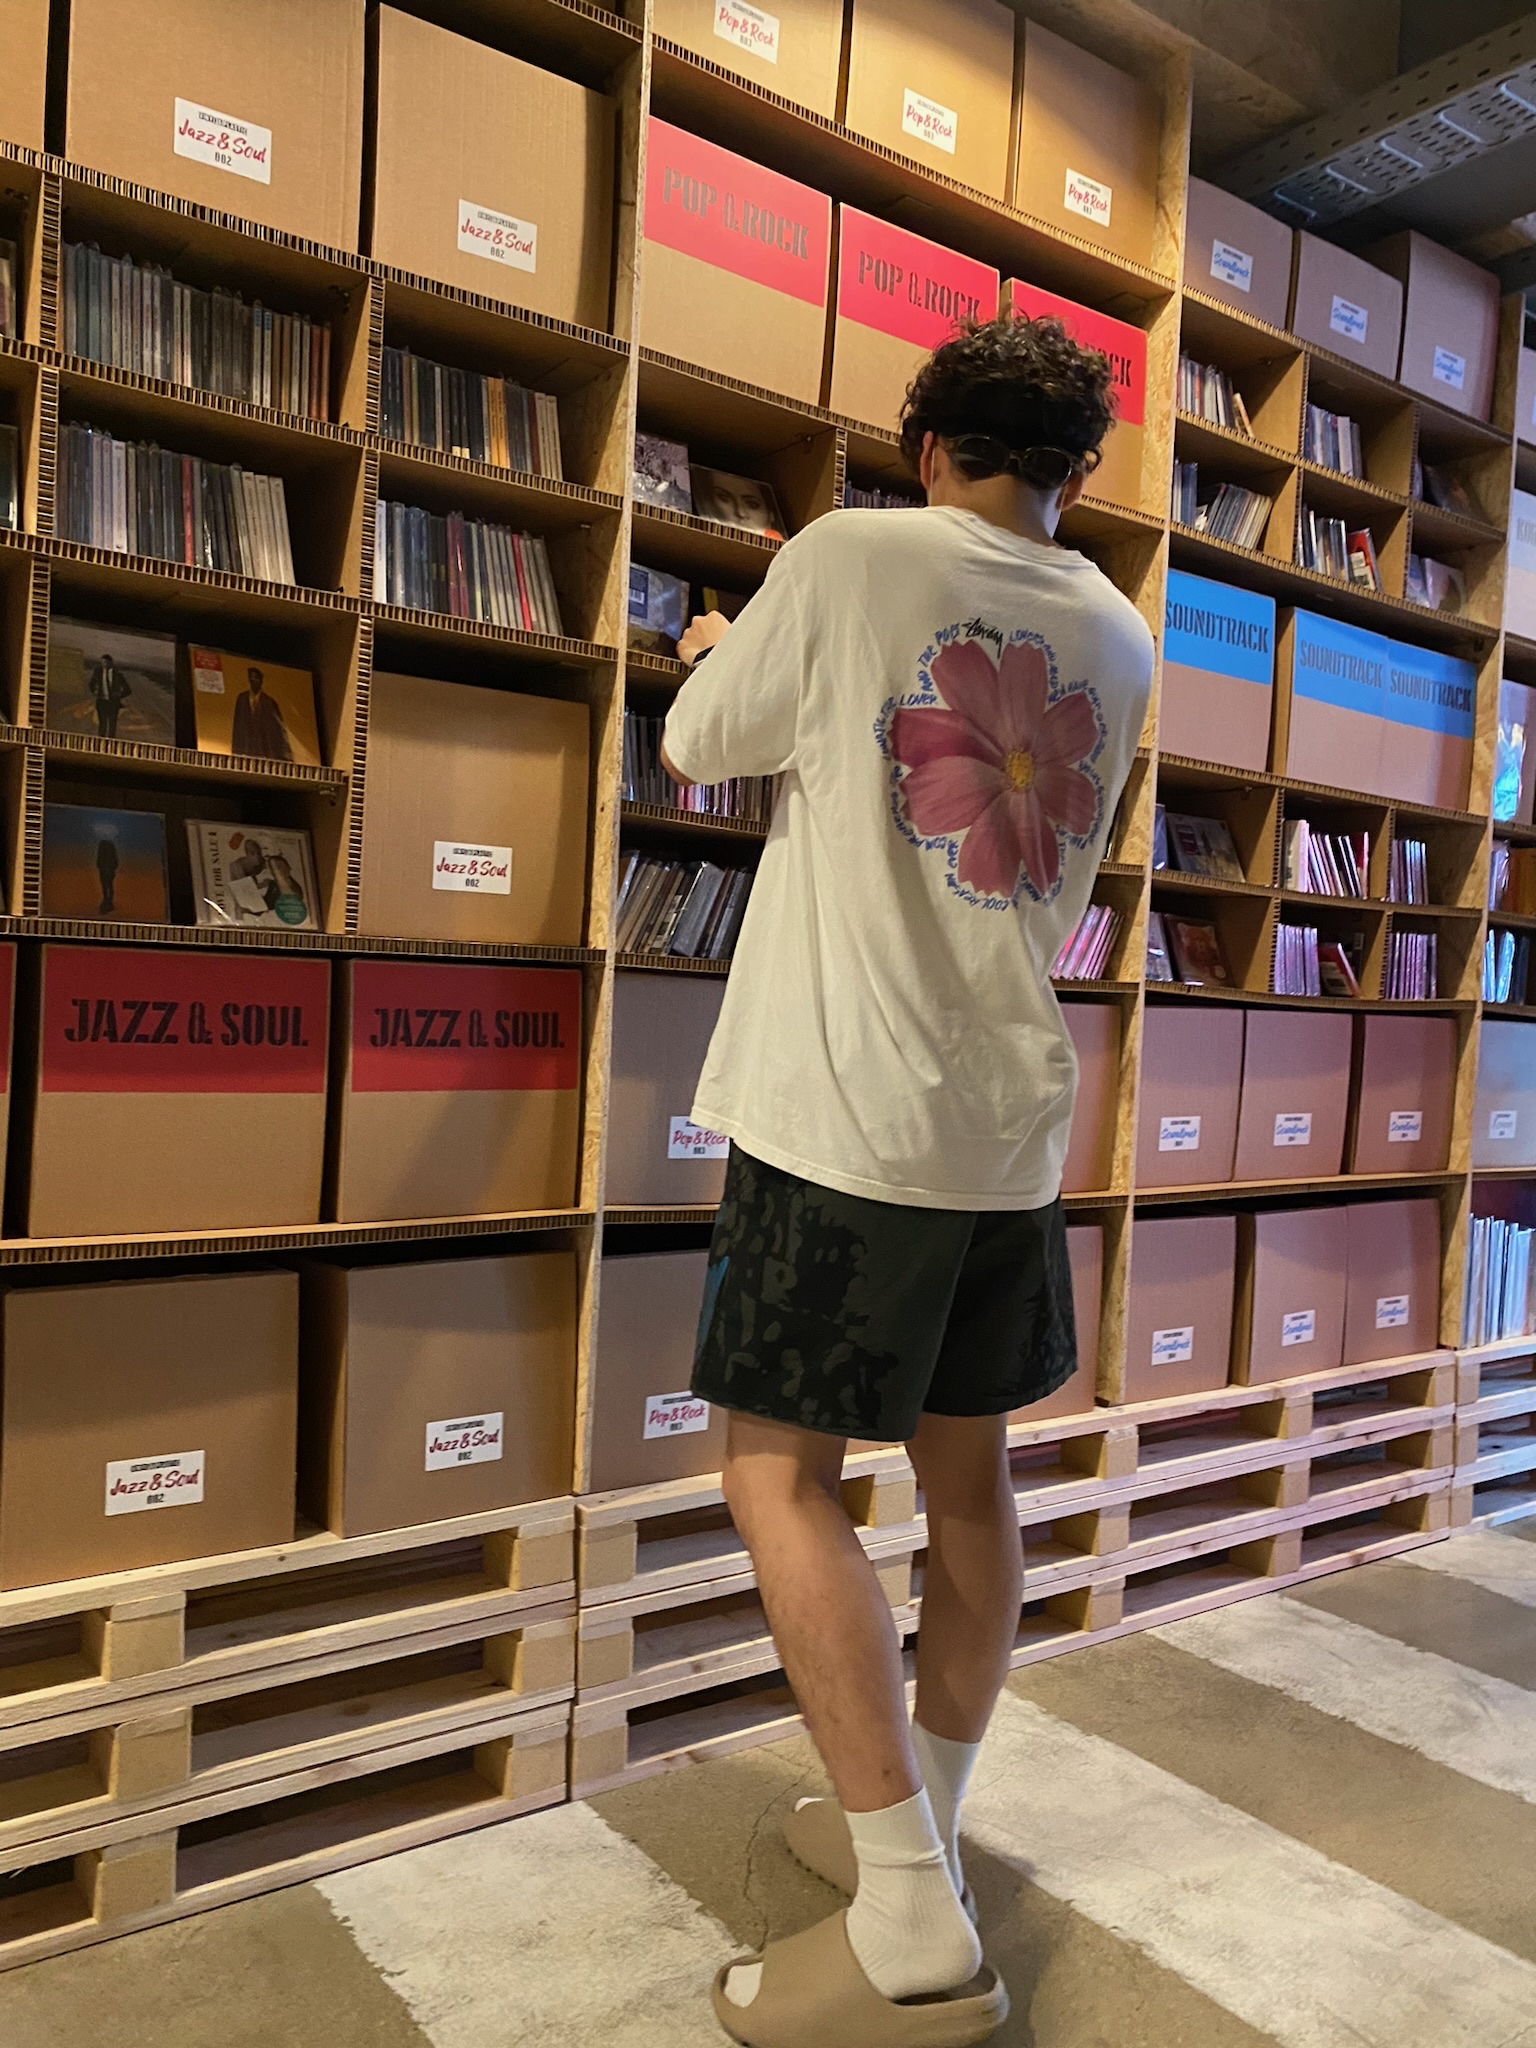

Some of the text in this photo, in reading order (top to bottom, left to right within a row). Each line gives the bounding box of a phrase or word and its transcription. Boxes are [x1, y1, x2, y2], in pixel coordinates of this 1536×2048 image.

[214, 151, 232, 167] 002
[663, 165, 809, 261] POP & ROCK
[489, 246, 506, 260] 002
[858, 250, 904, 297] POP
[924, 277, 980, 322] ROCK
[1165, 598, 1269, 654] SOUNDTRACK
[1299, 638, 1383, 689] SOUNDTRACK
[1389, 667, 1473, 714] SOUNDTRACK
[465, 878, 480, 888] 002
[64, 998, 309, 1047] JAZZ & SOUL
[369, 1007, 566, 1049] JAZZ & SOUL
